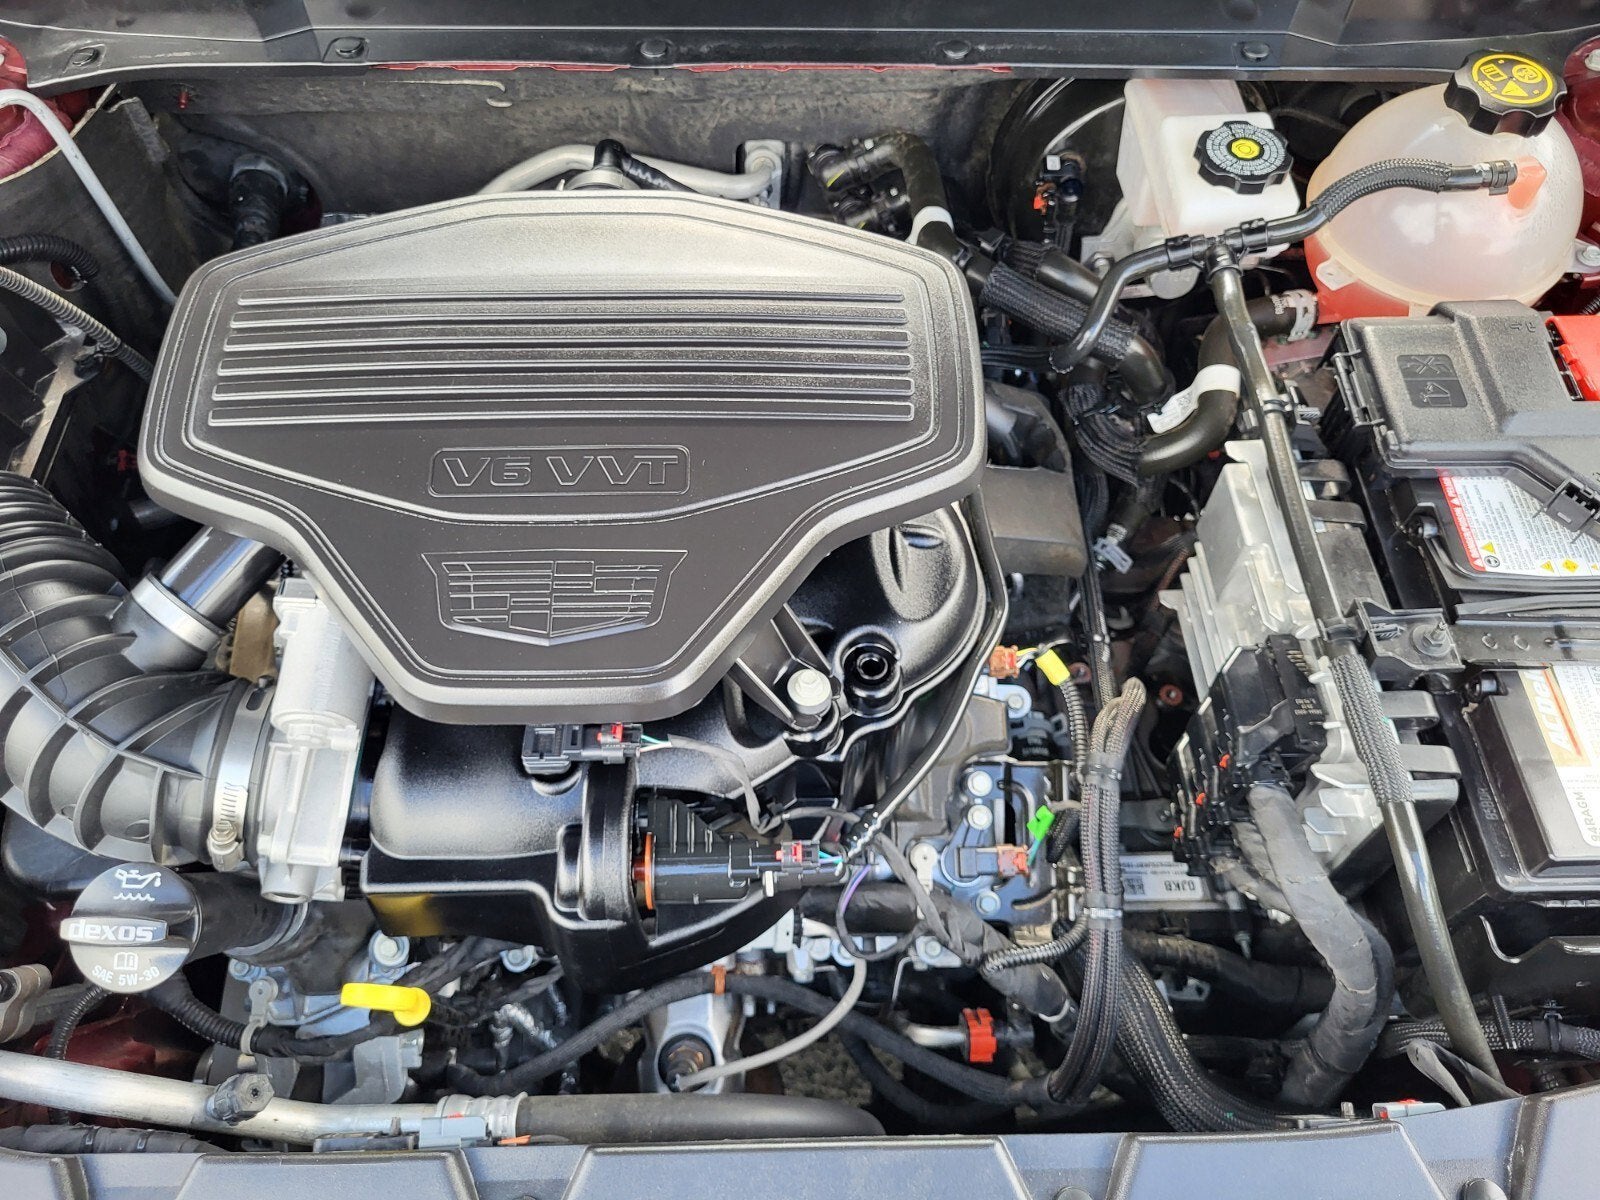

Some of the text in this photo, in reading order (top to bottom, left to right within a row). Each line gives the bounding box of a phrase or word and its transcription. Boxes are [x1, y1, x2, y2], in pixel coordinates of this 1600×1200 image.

[443, 455, 679, 487] V6 VVT
[69, 919, 155, 942] dexos
[92, 964, 160, 987] SAE 5W-30
